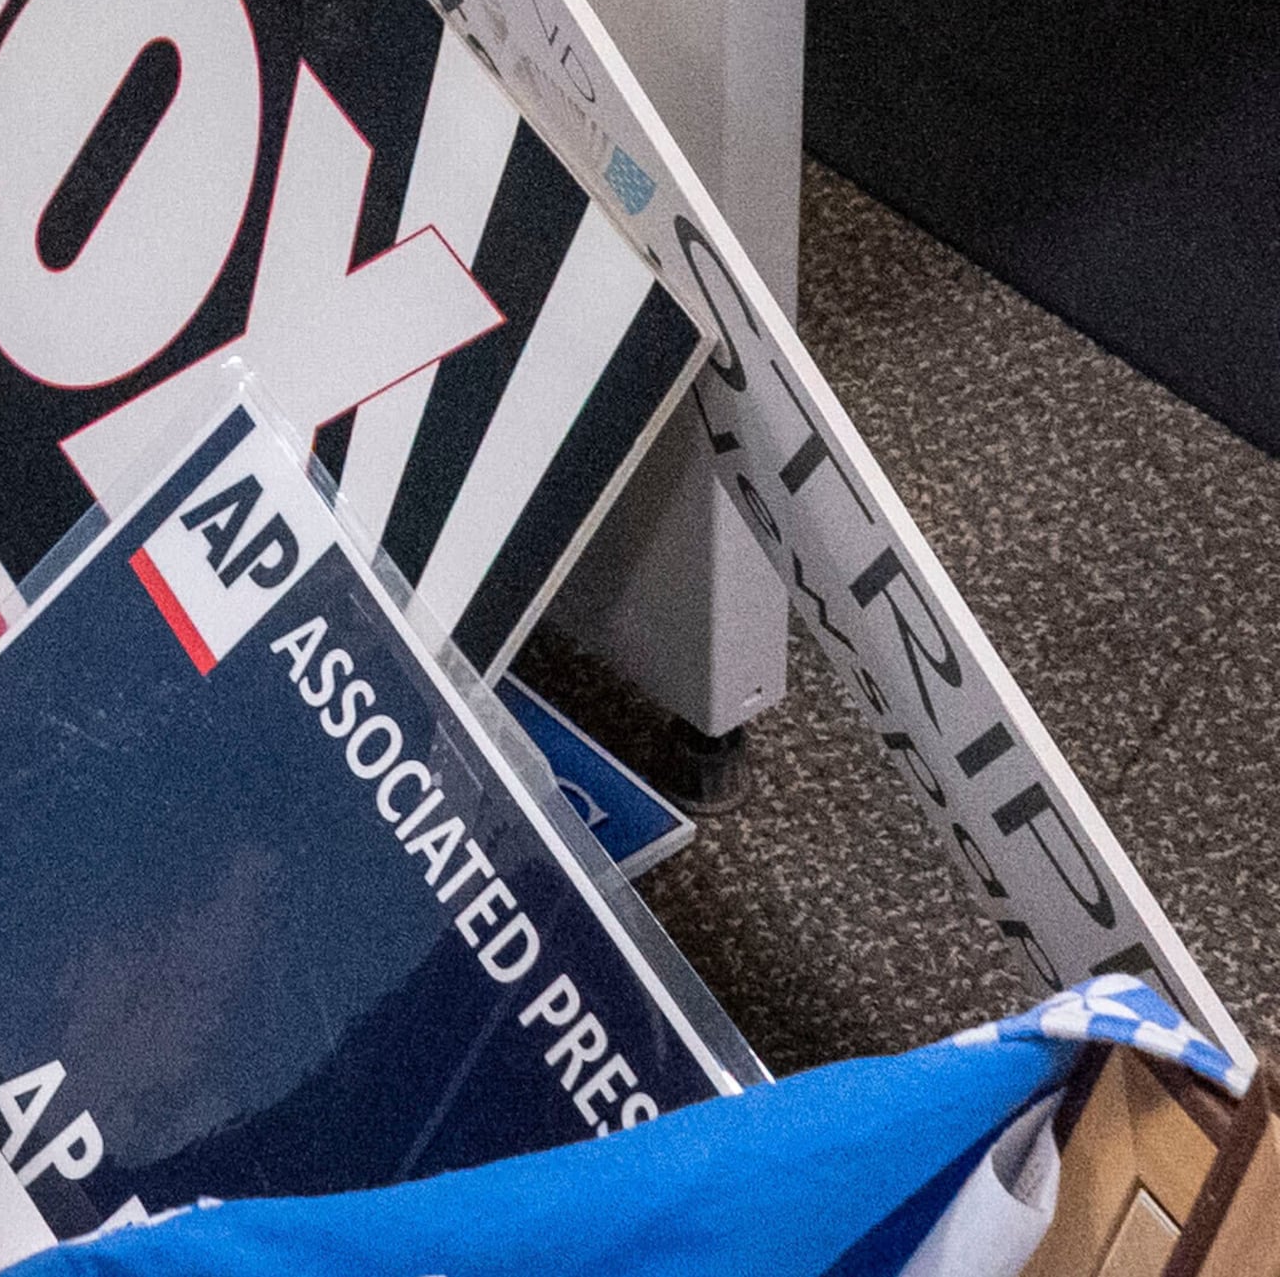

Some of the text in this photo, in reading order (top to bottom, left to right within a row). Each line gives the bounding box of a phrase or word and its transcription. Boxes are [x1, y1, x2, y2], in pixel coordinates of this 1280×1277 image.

[179, 473, 300, 590] AP
[692, 382, 1062, 992] Newspap
[271, 616, 659, 1138] ASSOCIATED PRES
